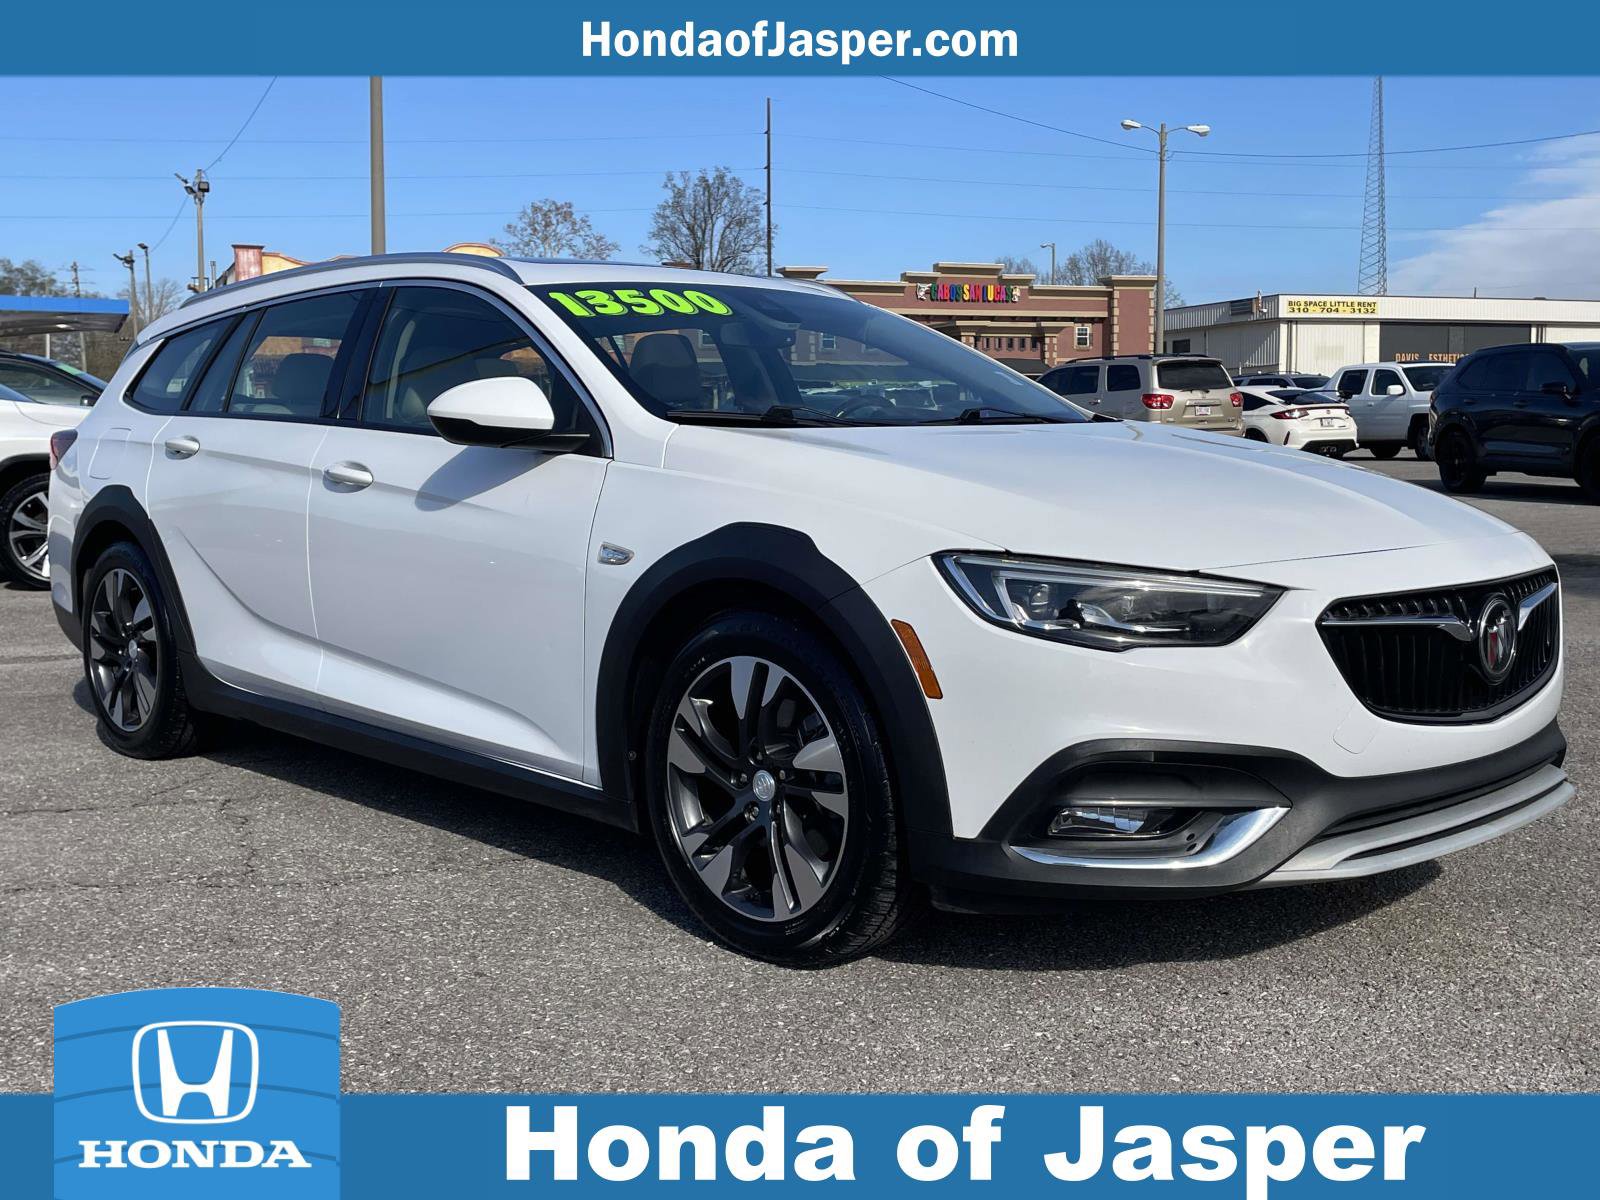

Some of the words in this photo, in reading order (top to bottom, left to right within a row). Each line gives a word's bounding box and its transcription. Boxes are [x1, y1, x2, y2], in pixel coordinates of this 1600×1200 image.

[930, 283, 960, 301] CABOS
[963, 283, 980, 301] SAN
[982, 284, 1012, 302] LUCAS
[548, 288, 732, 318] 13500
[1395, 353, 1419, 362] DAVIS
